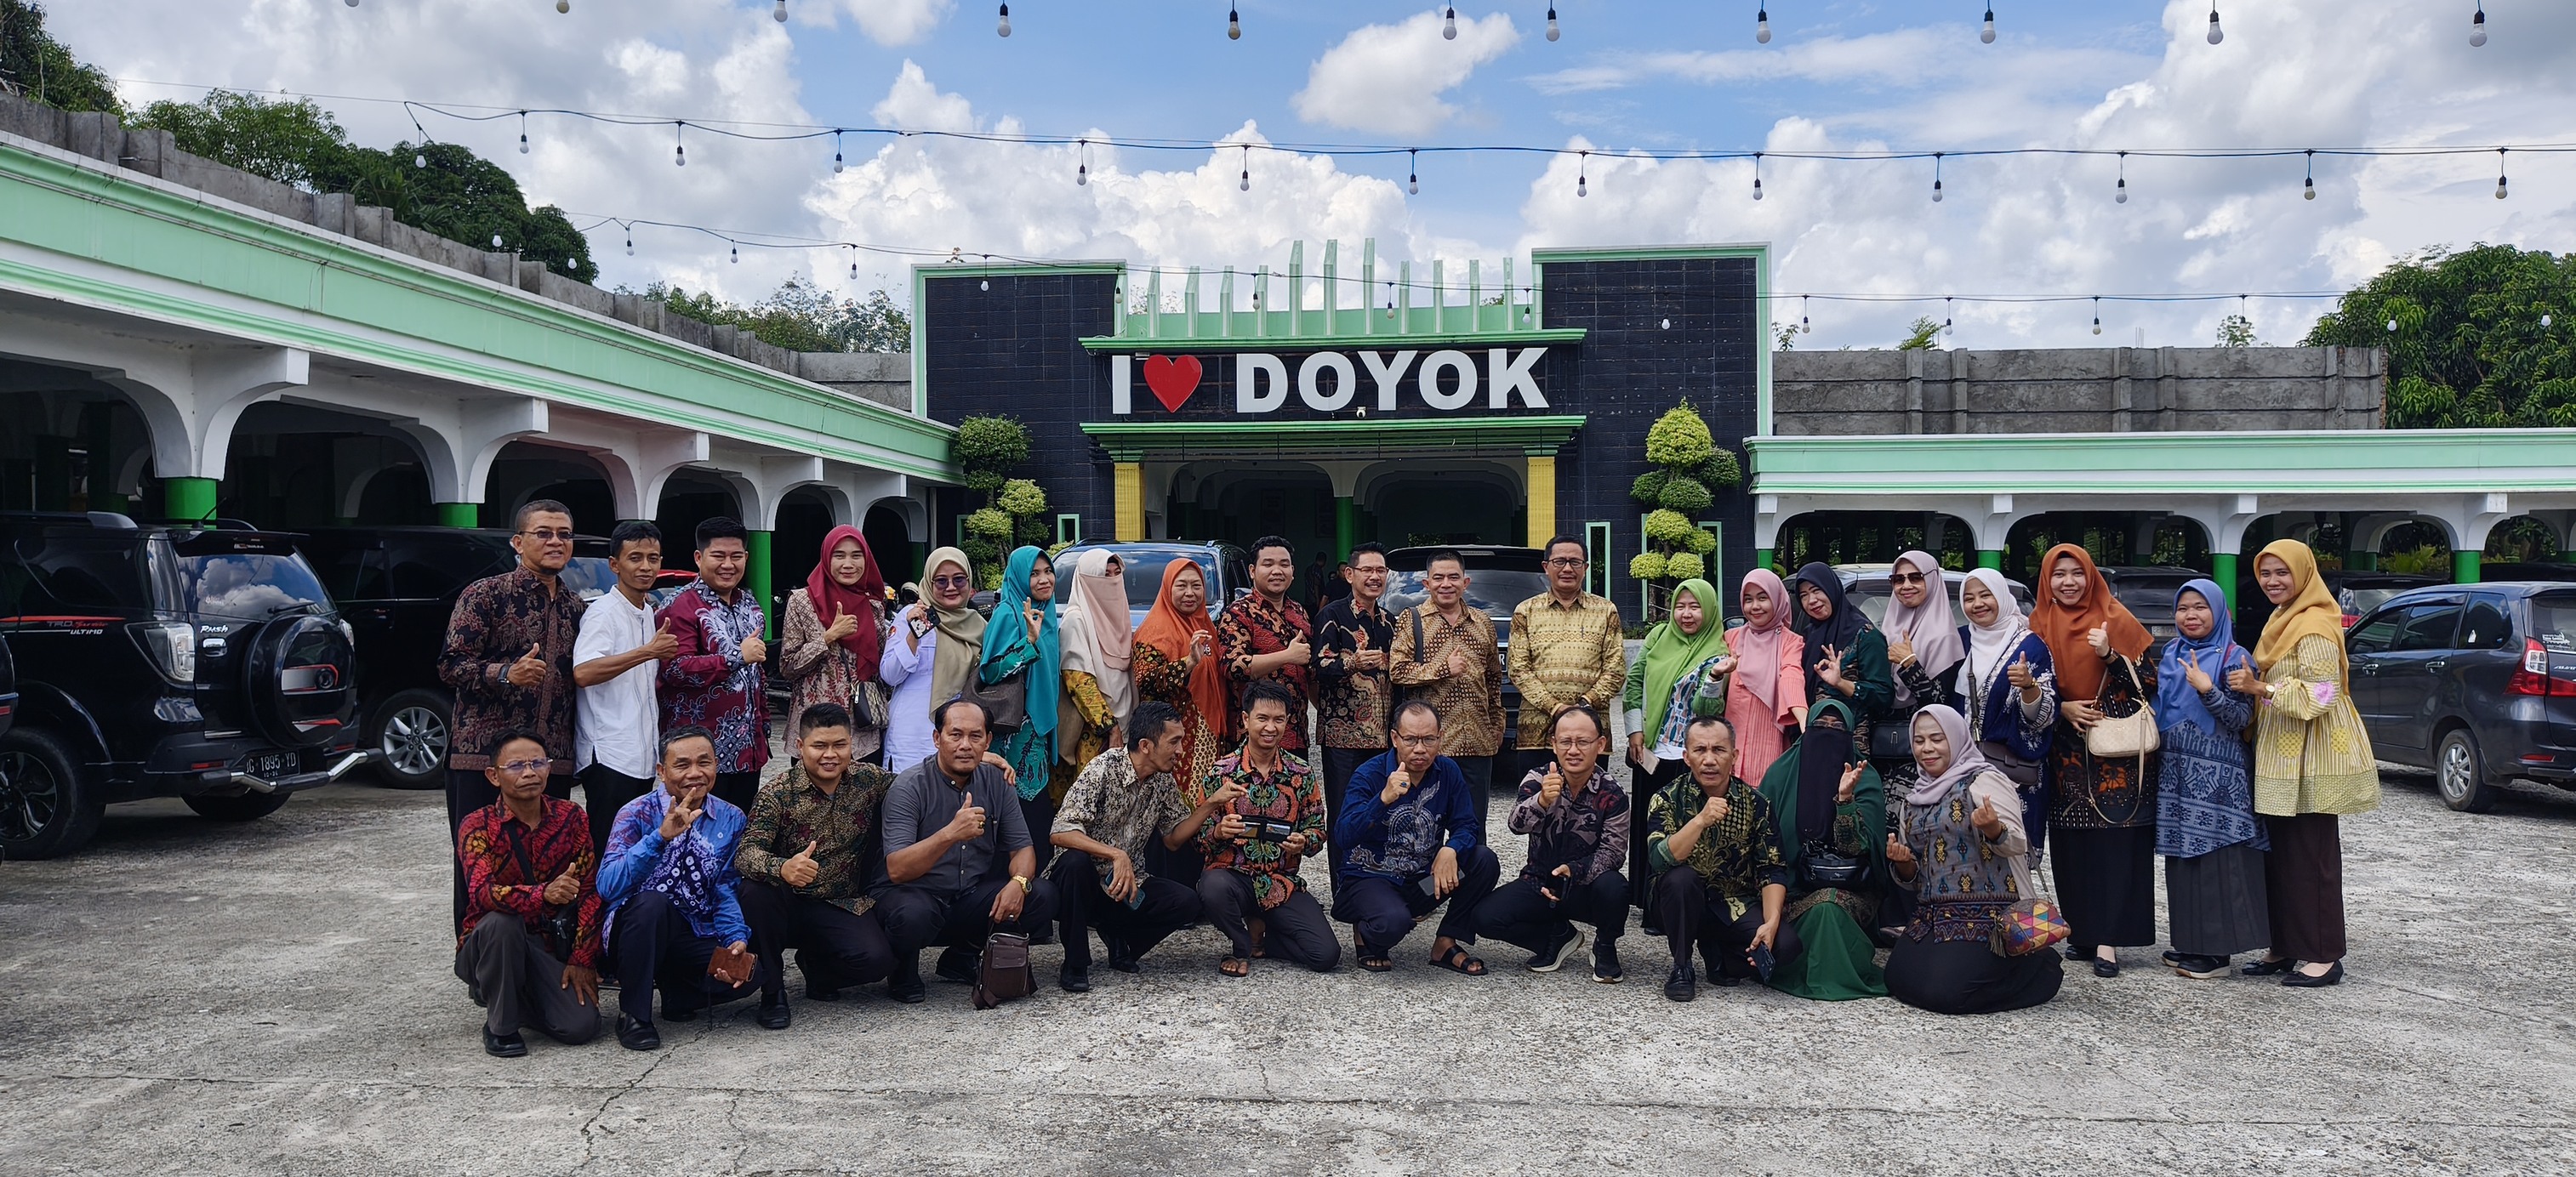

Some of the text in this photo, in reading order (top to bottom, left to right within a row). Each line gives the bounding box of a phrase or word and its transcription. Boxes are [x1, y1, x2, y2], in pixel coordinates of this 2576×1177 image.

[1112, 347, 1550, 414] I DOYOK
[200, 624, 229, 634] Rush
[260, 754, 281, 771] 1895
[285, 752, 296, 767] YD
